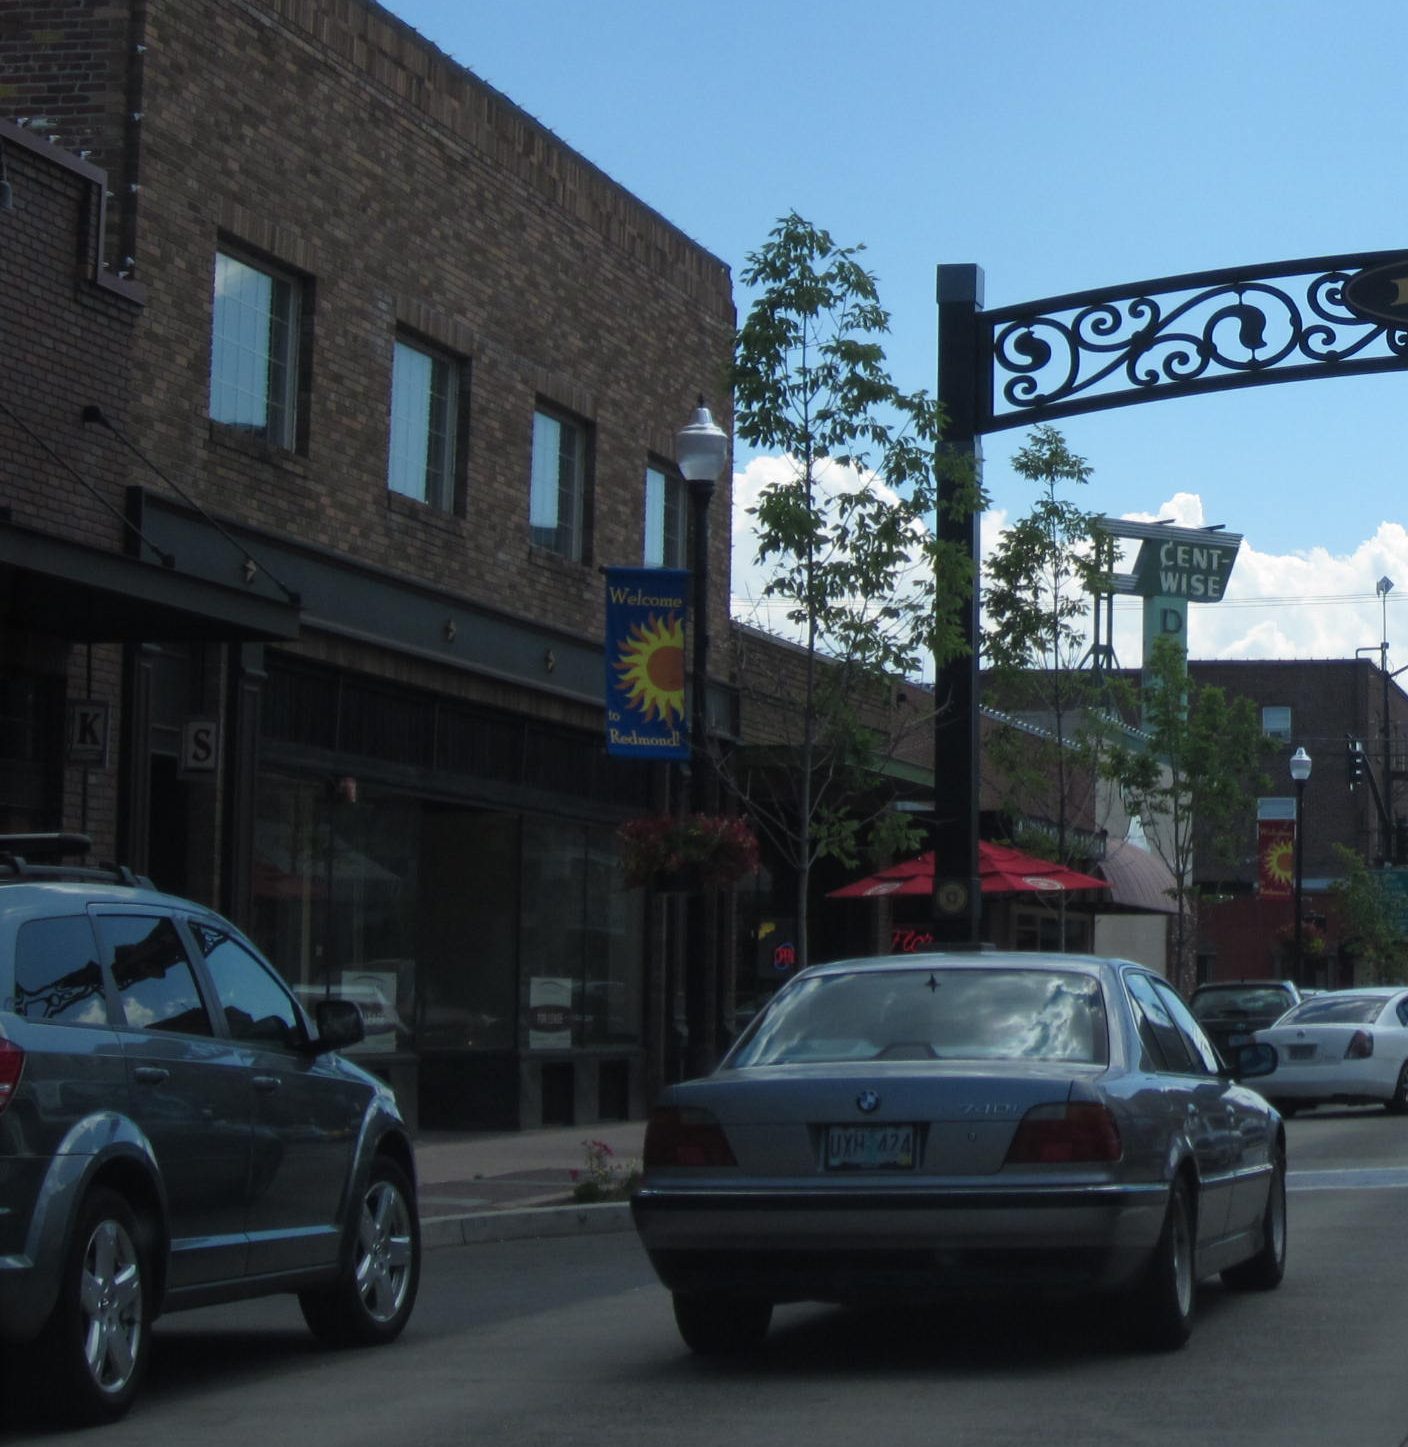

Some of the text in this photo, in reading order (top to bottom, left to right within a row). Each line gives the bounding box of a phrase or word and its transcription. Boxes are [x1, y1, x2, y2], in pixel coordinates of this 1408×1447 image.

[1160, 570, 1220, 597] WISE
[609, 586, 683, 608] Welcome
[608, 708, 620, 722] to
[78, 712, 101, 745] K
[609, 728, 680, 748] Redmond!
[192, 728, 212, 762] S
